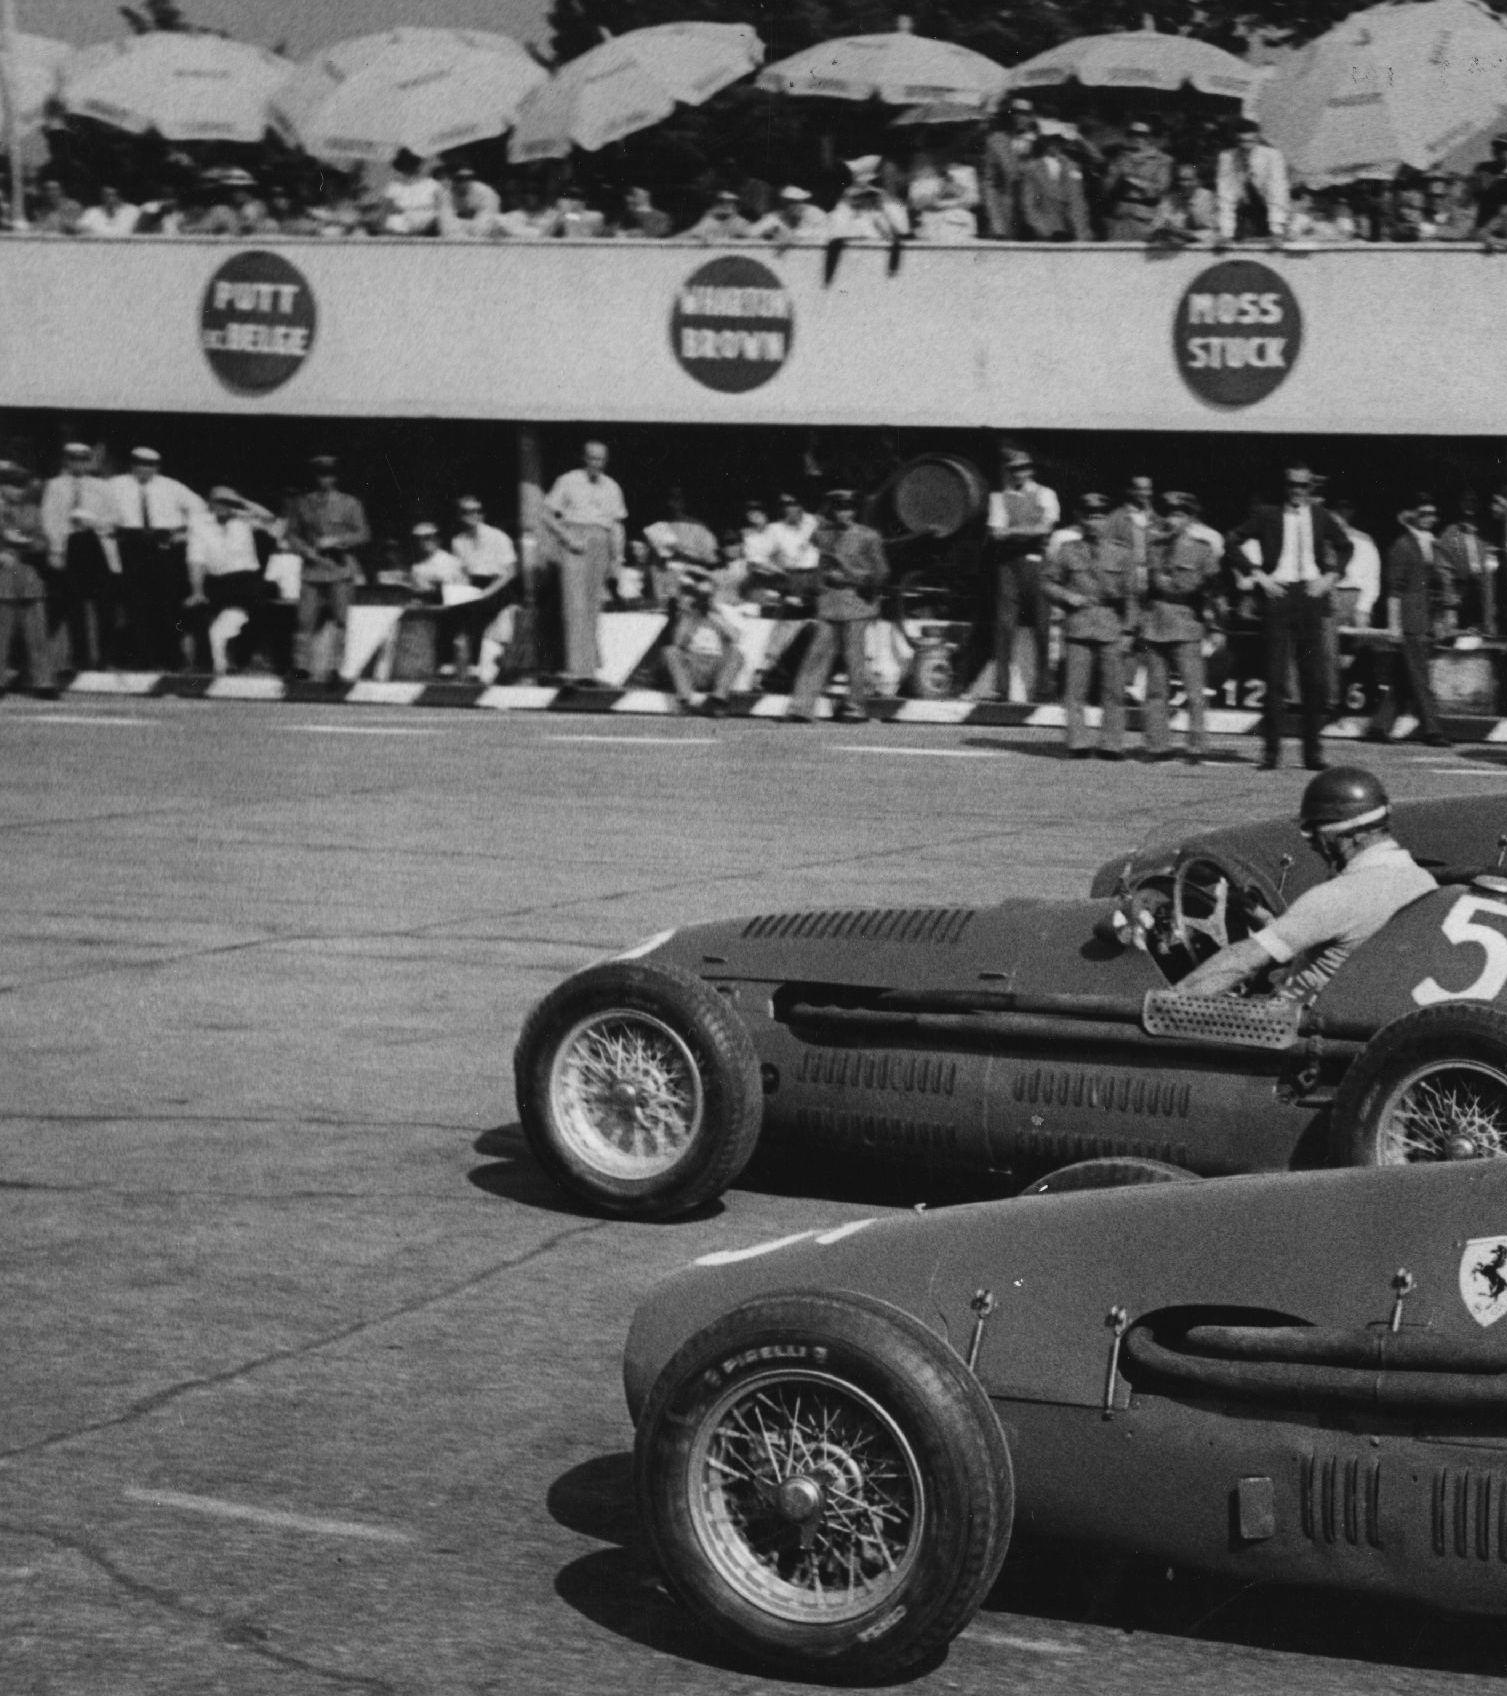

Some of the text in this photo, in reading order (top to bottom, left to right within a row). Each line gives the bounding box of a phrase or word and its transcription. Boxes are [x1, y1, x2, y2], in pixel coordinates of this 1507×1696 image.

[1188, 292, 1283, 324] MOSS
[681, 327, 785, 361] BROWN
[1187, 336, 1287, 369] STUCK
[722, 1344, 807, 1373] PIRELLI
